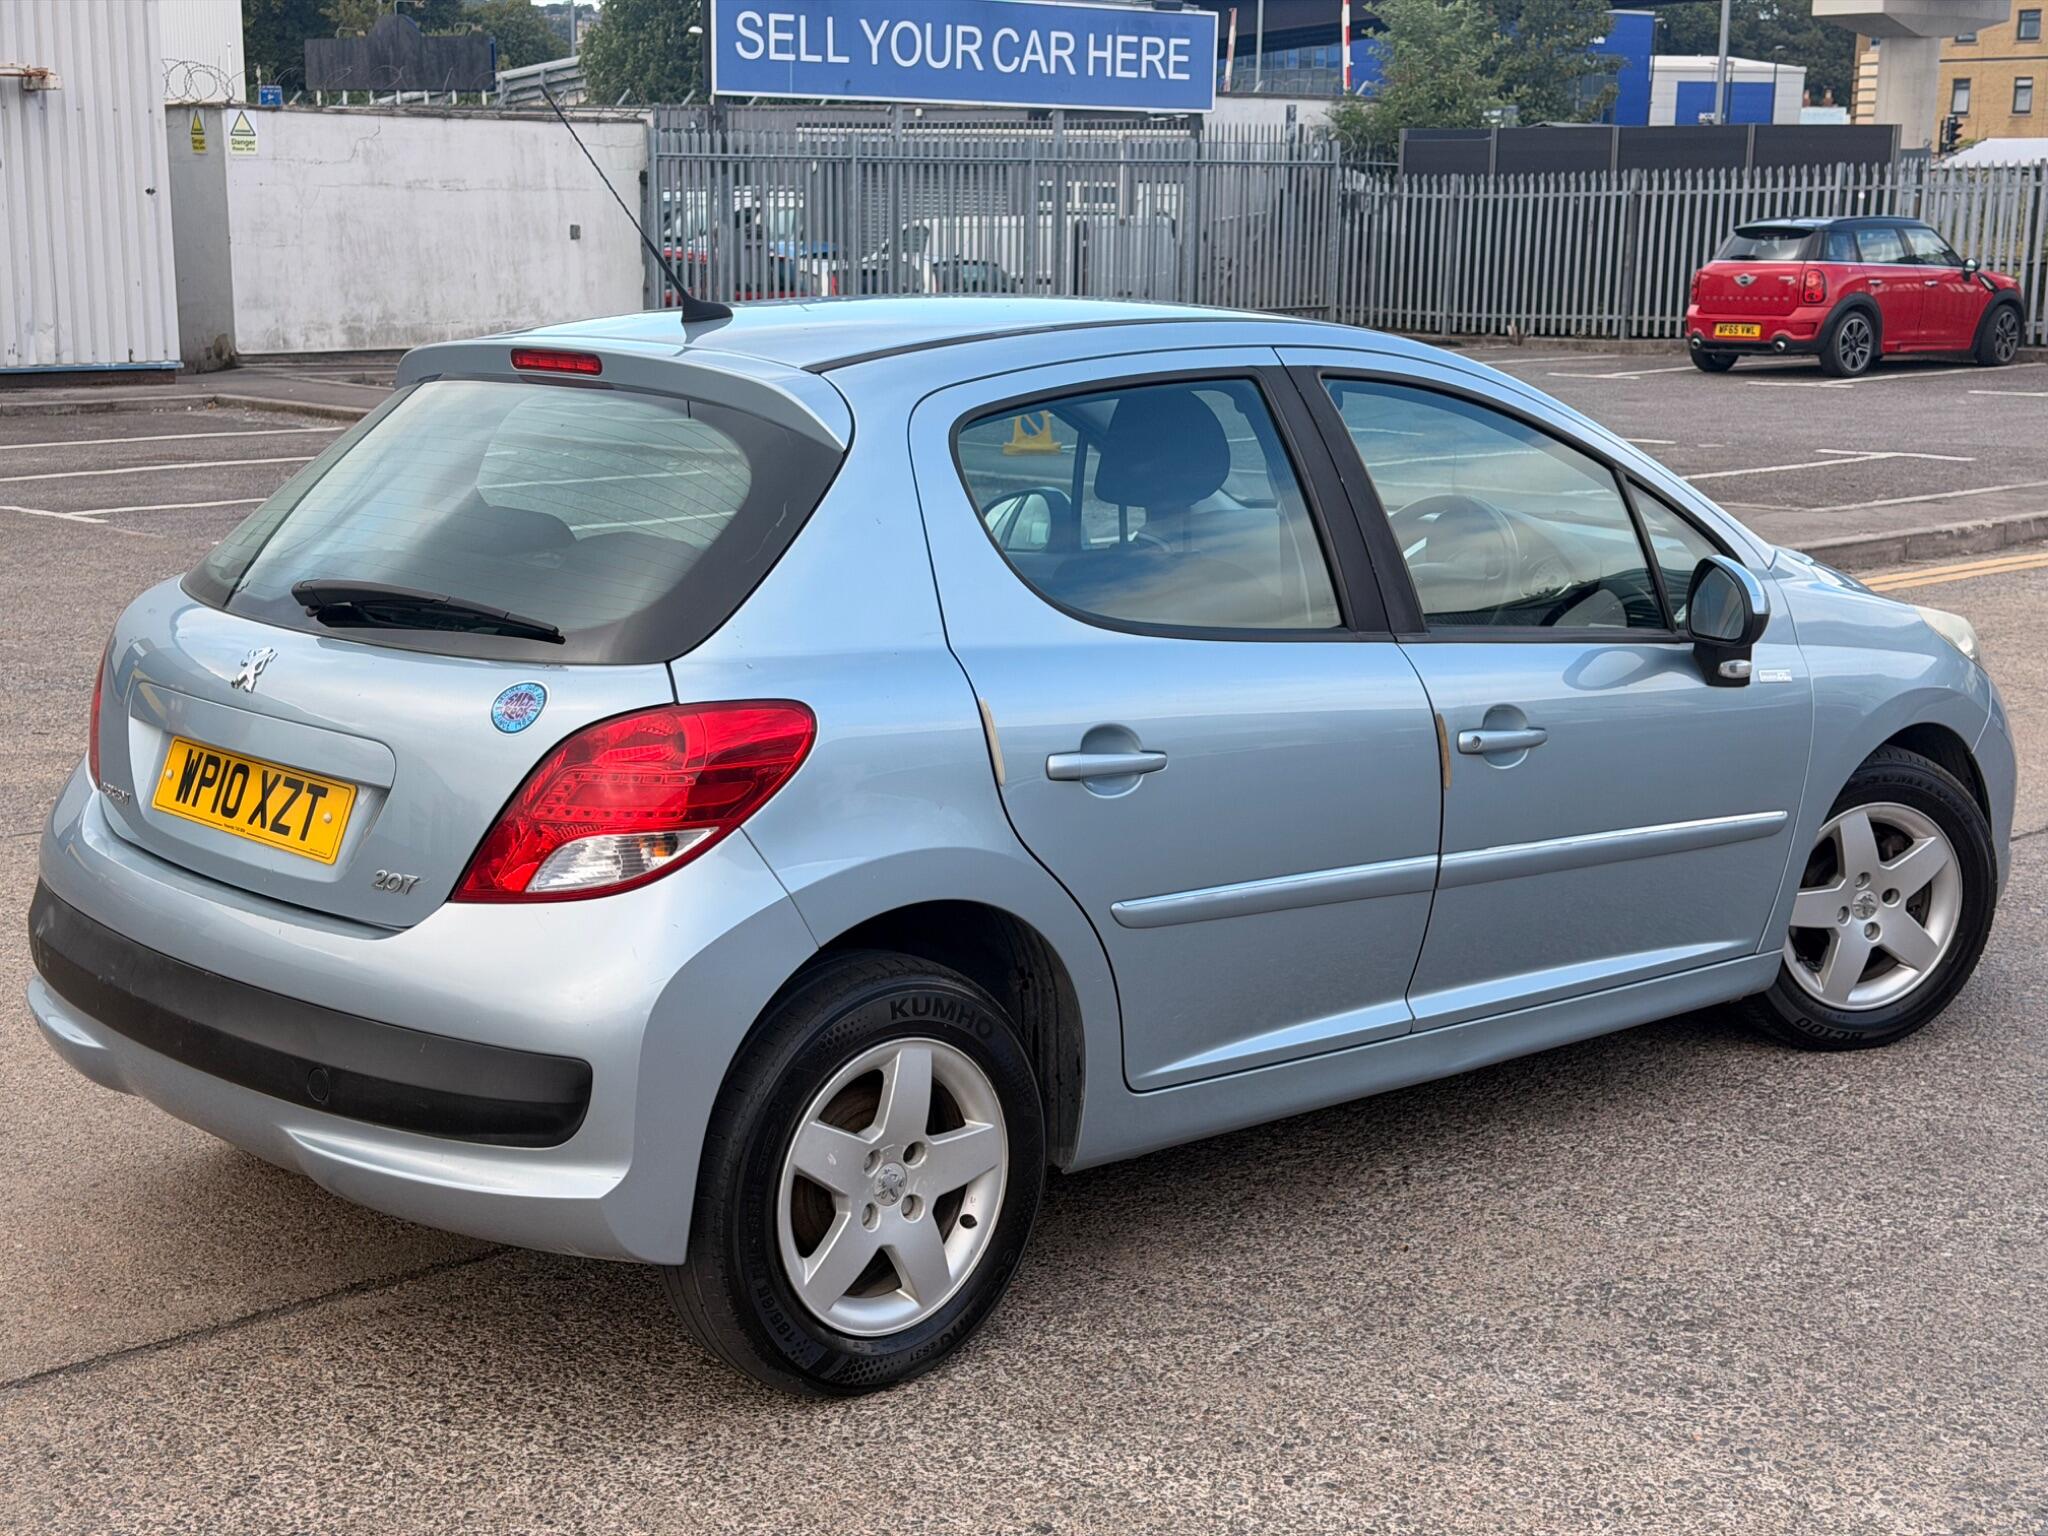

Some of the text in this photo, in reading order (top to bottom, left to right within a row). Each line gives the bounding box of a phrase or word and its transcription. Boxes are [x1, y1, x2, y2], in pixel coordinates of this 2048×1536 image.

[735, 10, 1191, 81] SELL YOUR CAR HERE
[231, 138, 256, 147] Danger
[1719, 323, 1739, 335] WF65
[504, 692, 535, 707] SALT
[175, 748, 329, 842] WP10 XZT
[374, 869, 420, 895] 207
[890, 997, 993, 1039] KUMHO
